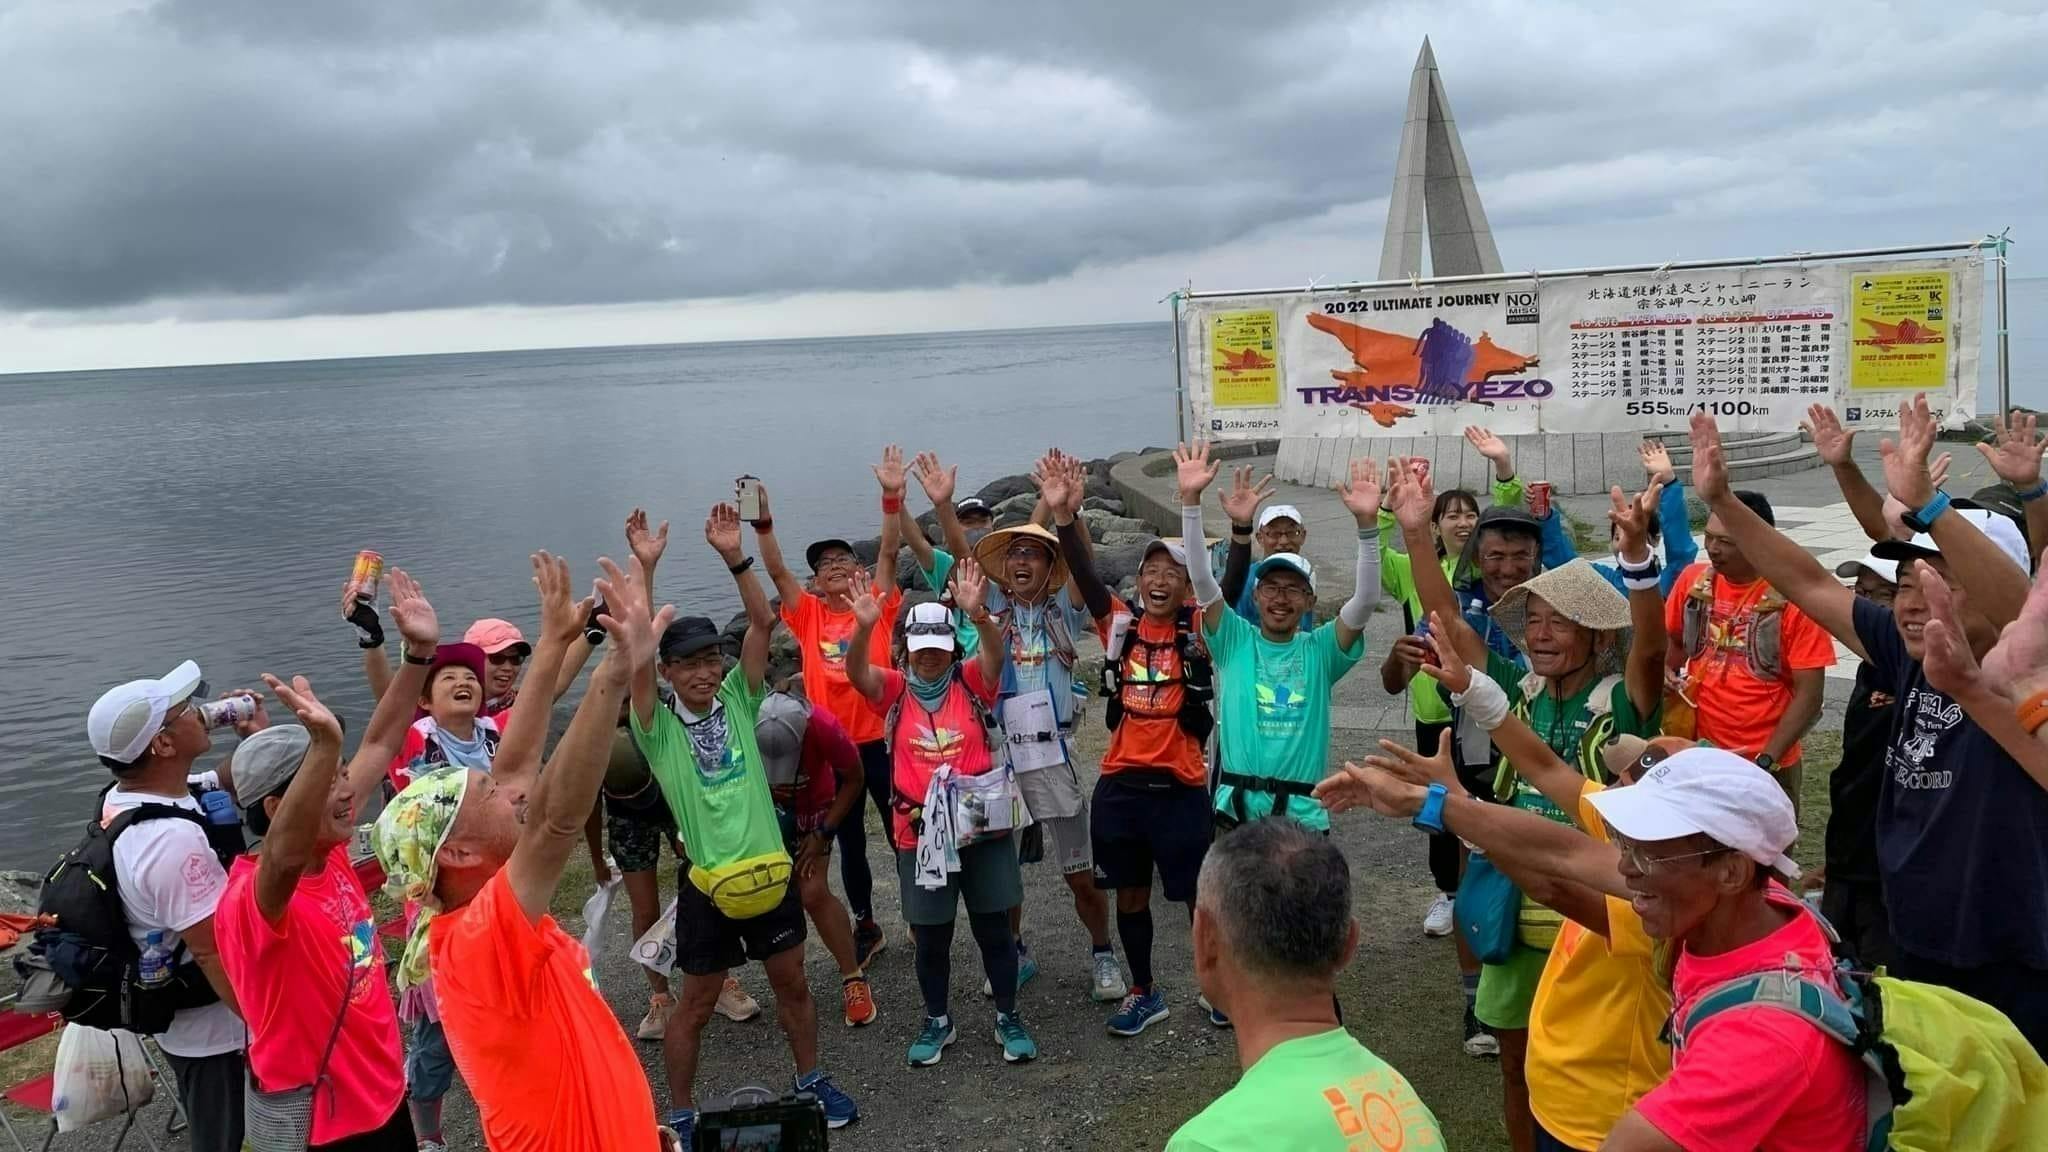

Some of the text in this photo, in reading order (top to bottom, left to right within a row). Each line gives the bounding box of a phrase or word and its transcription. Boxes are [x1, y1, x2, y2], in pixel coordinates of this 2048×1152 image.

[1324, 293, 1500, 314] 2022 ULTIMATE JOURNEY
[1507, 293, 1537, 306] NO!
[1697, 327, 1743, 335] ステージ1
[1571, 332, 1614, 340] ステージ1
[1697, 336, 1745, 345] ステージ2
[1571, 341, 1616, 350] ステージ2
[1572, 351, 1616, 359] ステージ3
[1697, 346, 1745, 355] ステージ3
[1572, 360, 1616, 369] ステージ4
[1697, 357, 1744, 366] ステージ4
[1572, 370, 1616, 378] ステージ5
[1697, 366, 1744, 375] ステージ5
[1572, 380, 1616, 388] ステージ6
[1697, 376, 1744, 385] ステージ6
[1296, 379, 1553, 404] TRANS YEZO
[1572, 389, 1616, 398] ステージ7
[1697, 386, 1744, 395] ステージ7
[1484, 404, 1542, 413] RUN
